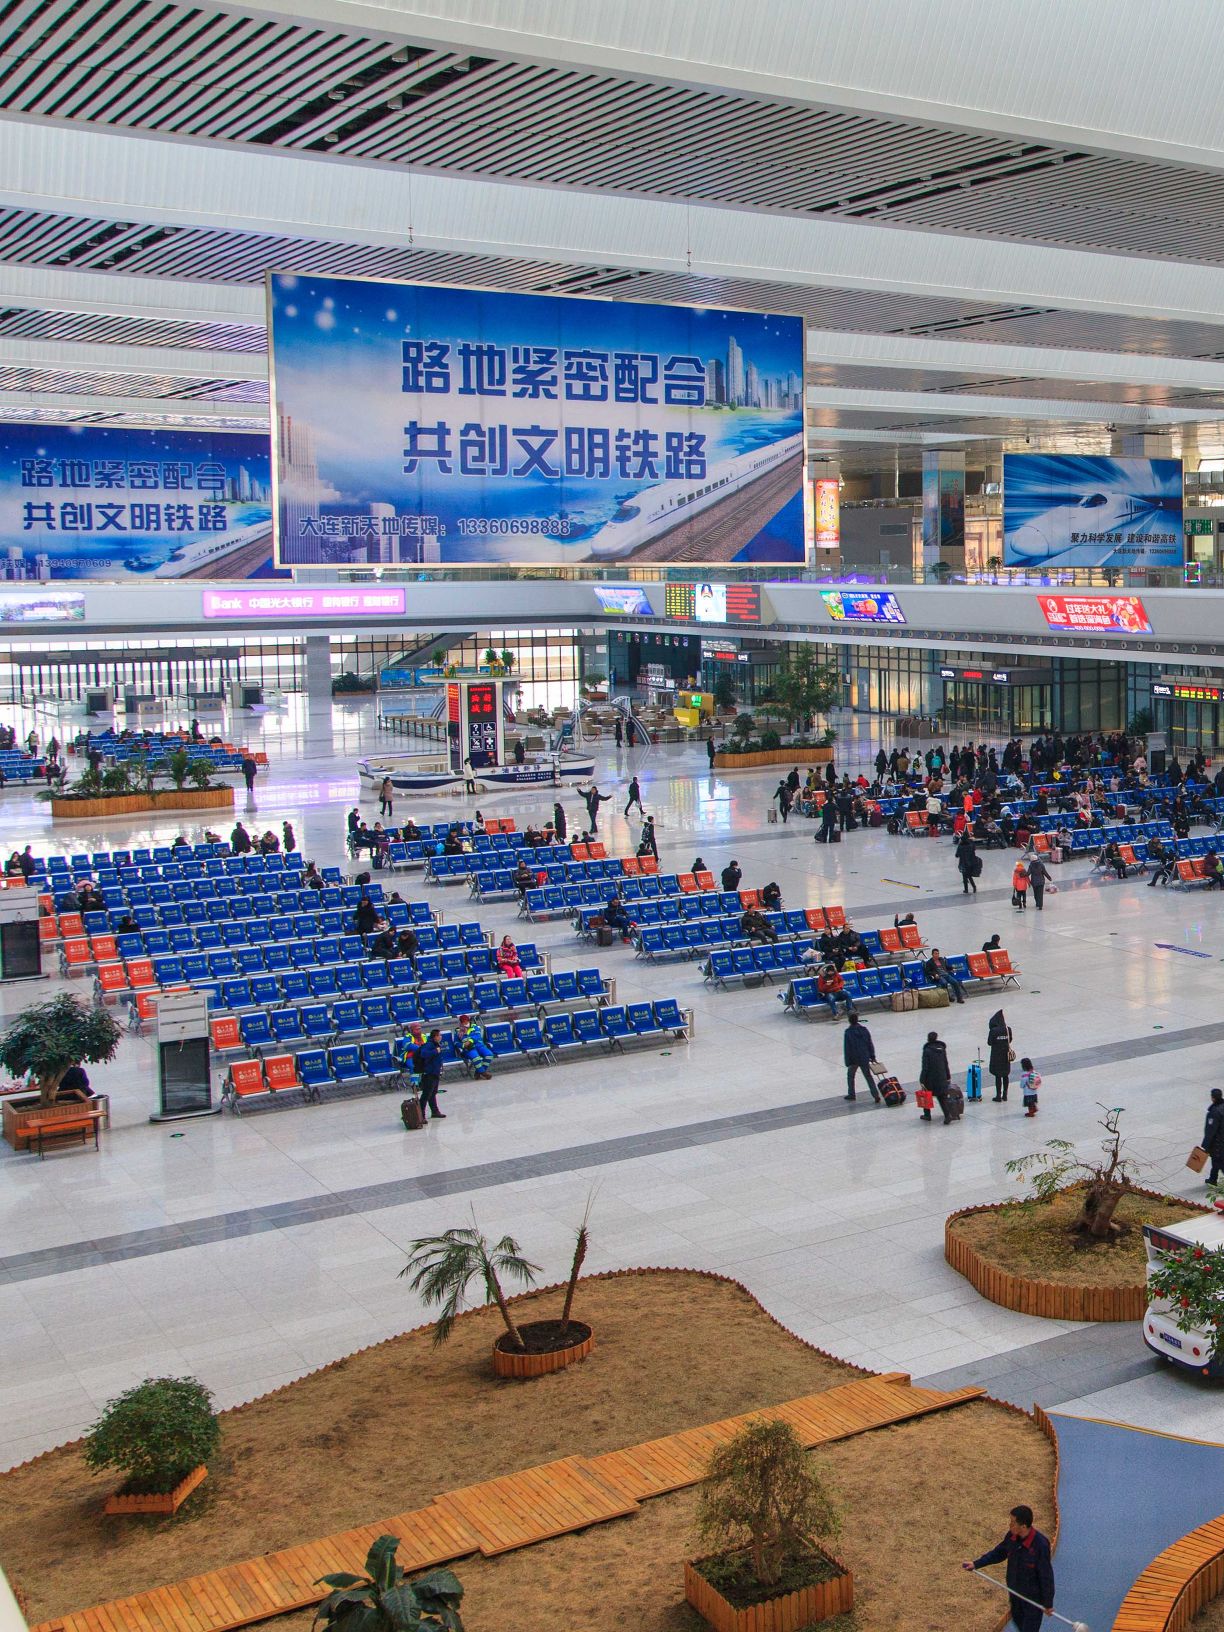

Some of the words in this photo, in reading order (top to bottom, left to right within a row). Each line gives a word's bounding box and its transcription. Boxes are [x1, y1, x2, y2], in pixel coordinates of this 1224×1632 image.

[401, 340, 706, 406] 路地紧密配合
[402, 420, 708, 481] 共创文明铁路
[20, 458, 227, 491] 路地紧密配合
[23, 501, 228, 532] 共创文明铁路
[457, 518, 571, 536] 13360698888
[1070, 532, 1122, 544] 聚力科学发展
[1126, 533, 1177, 545] 建设和谐高铁
